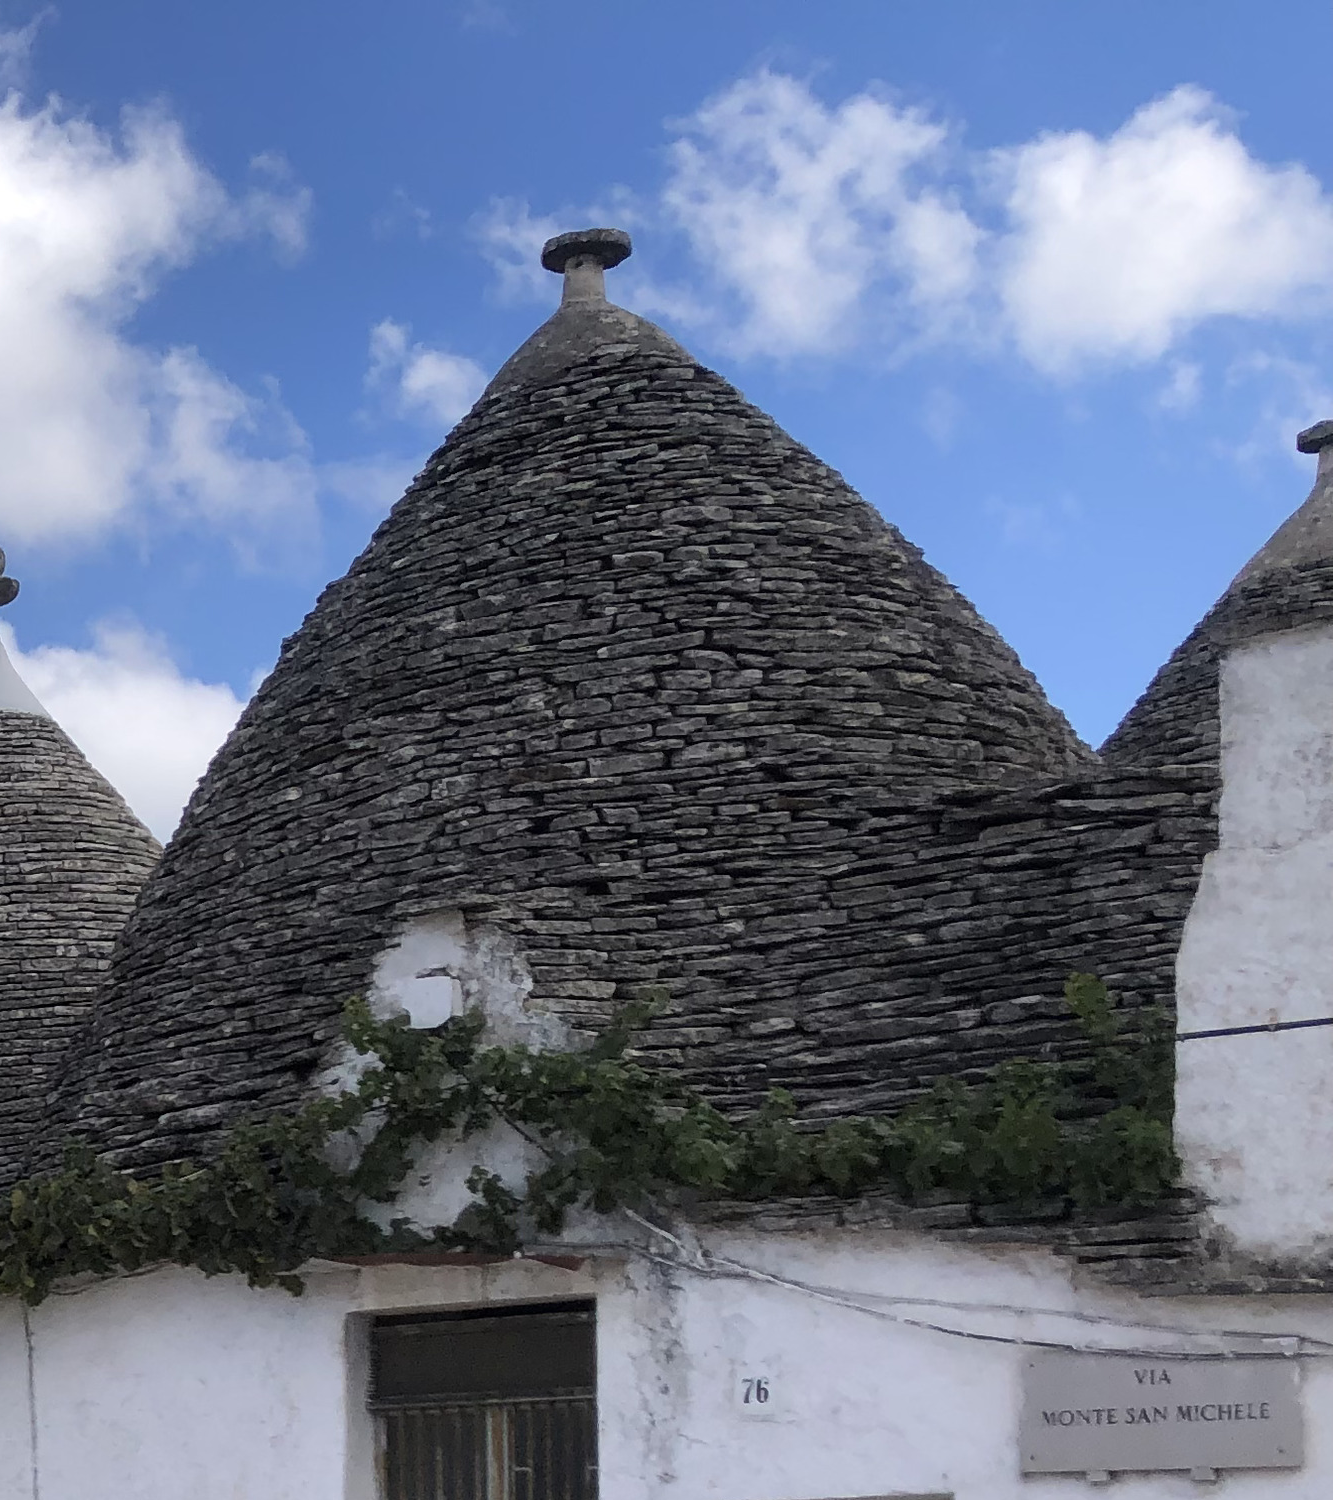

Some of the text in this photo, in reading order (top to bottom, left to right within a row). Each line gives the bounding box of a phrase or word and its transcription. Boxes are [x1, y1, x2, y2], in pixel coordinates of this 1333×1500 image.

[1134, 1368, 1172, 1386] VIA
[741, 1377, 769, 1404] 76
[1042, 1402, 1271, 1427] MONTE SAN MICHELE
